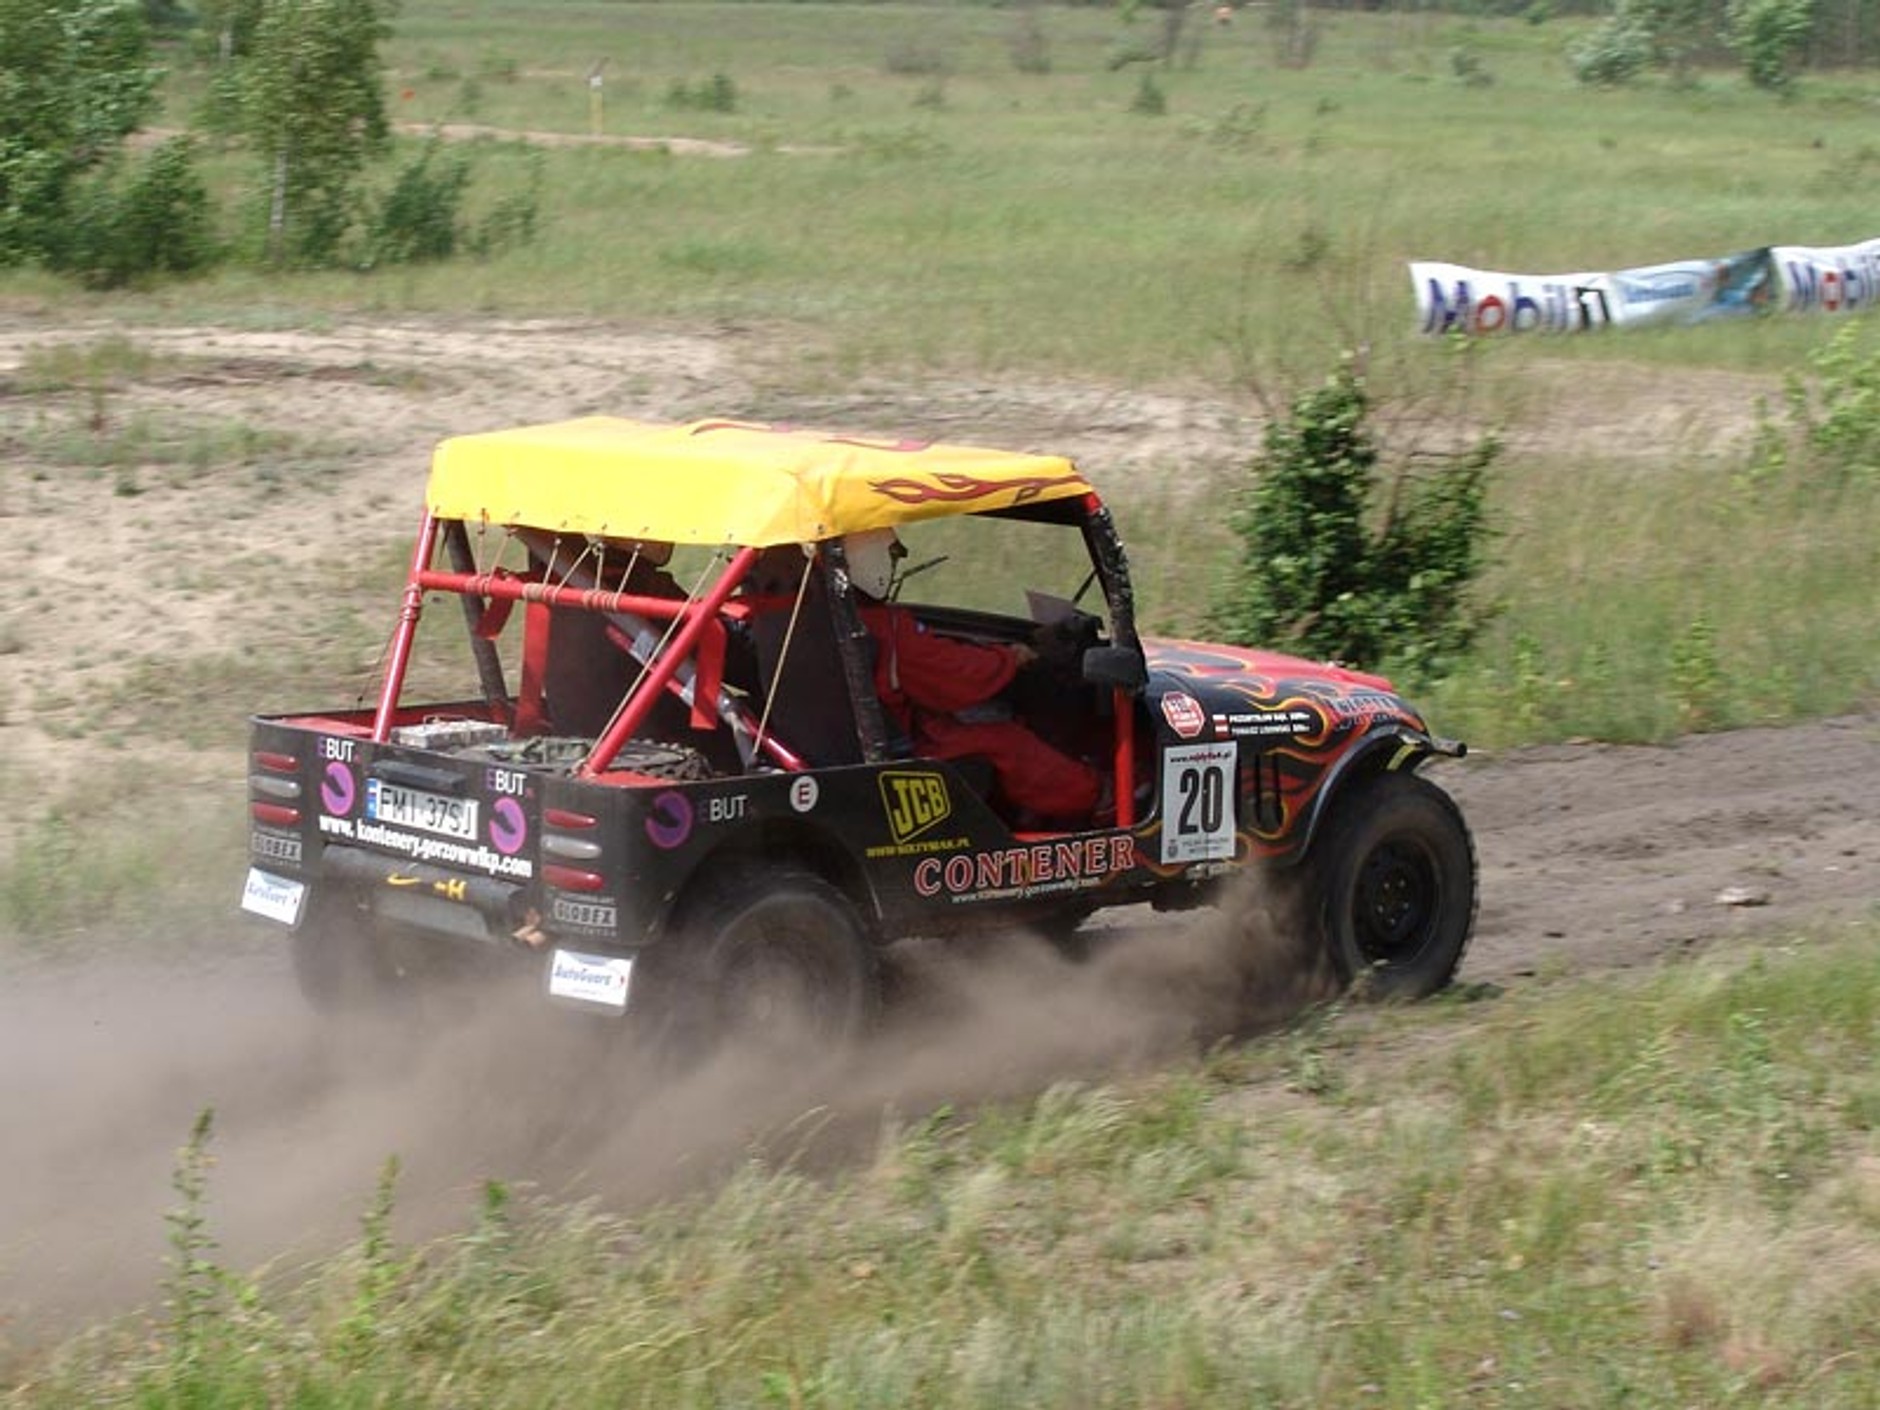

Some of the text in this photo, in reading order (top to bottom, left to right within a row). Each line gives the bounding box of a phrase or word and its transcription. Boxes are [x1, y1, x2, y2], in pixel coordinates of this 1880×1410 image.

[1422, 278, 1569, 335] Mobil
[892, 779, 946, 835] JCB
[1178, 766, 1223, 835] 20
[914, 834, 1135, 896] CONTENER
